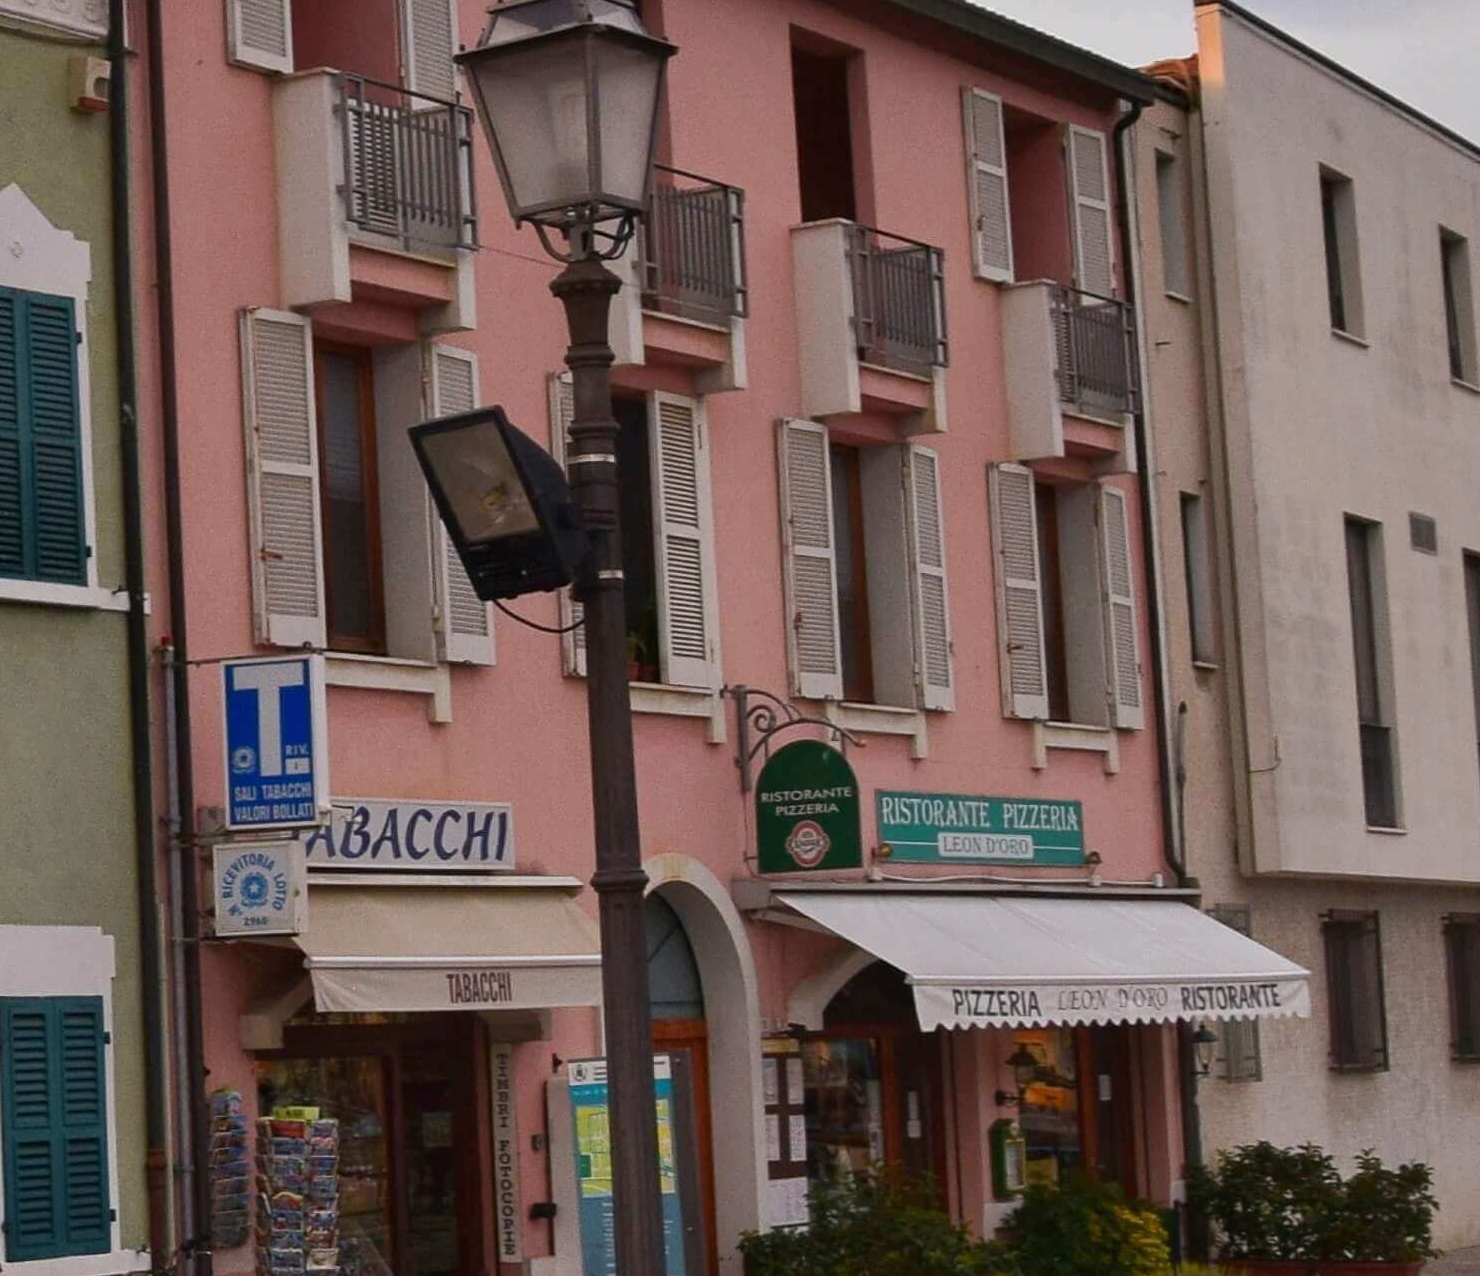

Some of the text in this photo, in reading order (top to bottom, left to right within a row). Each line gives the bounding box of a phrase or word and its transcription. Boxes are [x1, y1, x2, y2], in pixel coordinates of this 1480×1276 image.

[234, 783, 312, 801] SALI TABACCHI
[761, 786, 853, 803] RISTORANTE
[234, 803, 313, 822] VALORI BOLLATI
[775, 803, 840, 817] PIZZERIA
[882, 796, 1079, 831] RISTORANTE PIZZERIA
[293, 806, 507, 861] ABACCHI
[943, 836, 1030, 855] LEON D'ORO
[272, 872, 287, 911] LOTTO
[446, 972, 513, 1004] TABACCHI
[952, 983, 1281, 1017] PIZZERIA LEON D'ORO RISTORANTE
